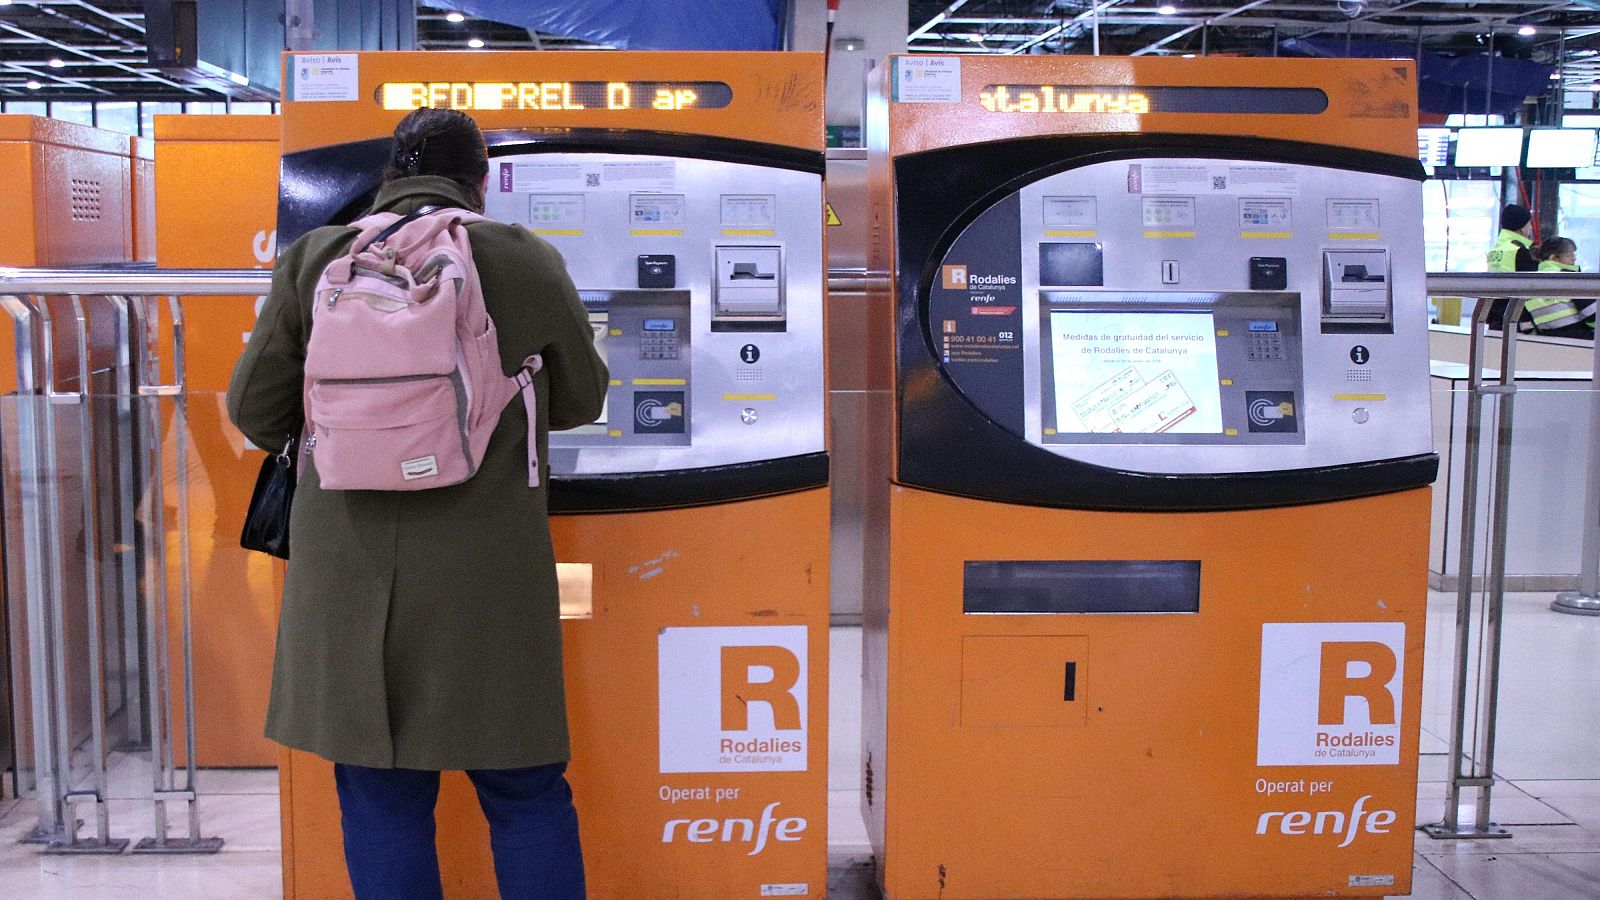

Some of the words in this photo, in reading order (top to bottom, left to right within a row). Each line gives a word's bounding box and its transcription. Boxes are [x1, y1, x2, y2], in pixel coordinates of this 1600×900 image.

[607, 82, 629, 109] D
[502, 167, 510, 190] renfe
[952, 269, 966, 283] R
[969, 275, 1016, 284] Rodalies
[970, 294, 995, 303] renfe
[966, 335, 975, 343] 41
[976, 335, 987, 343] 00
[988, 335, 997, 343] 41
[1063, 333, 1098, 341] Medidas
[1101, 333, 1112, 341] de
[1113, 333, 1154, 343] gratuidad
[1155, 333, 1169, 341] del
[1171, 333, 1204, 342] servicio
[1081, 346, 1092, 354] de
[1093, 346, 1131, 354] Rodalies
[1132, 346, 1143, 354] de
[1145, 346, 1188, 355] Catalunya
[720, 645, 802, 731] R
[1317, 641, 1396, 725] R
[719, 738, 802, 753] Rodalies
[1315, 732, 1395, 747] Rodalies
[719, 754, 733, 764] de
[734, 754, 782, 765] Catalunya
[1314, 749, 1327, 757] de
[1329, 748, 1376, 758] Catalunya
[658, 785, 711, 803] Operat
[715, 787, 740, 803] per
[1255, 778, 1304, 795] Operat
[1309, 780, 1334, 796] per
[661, 802, 808, 856] renfe
[1255, 795, 1397, 848] renfe
